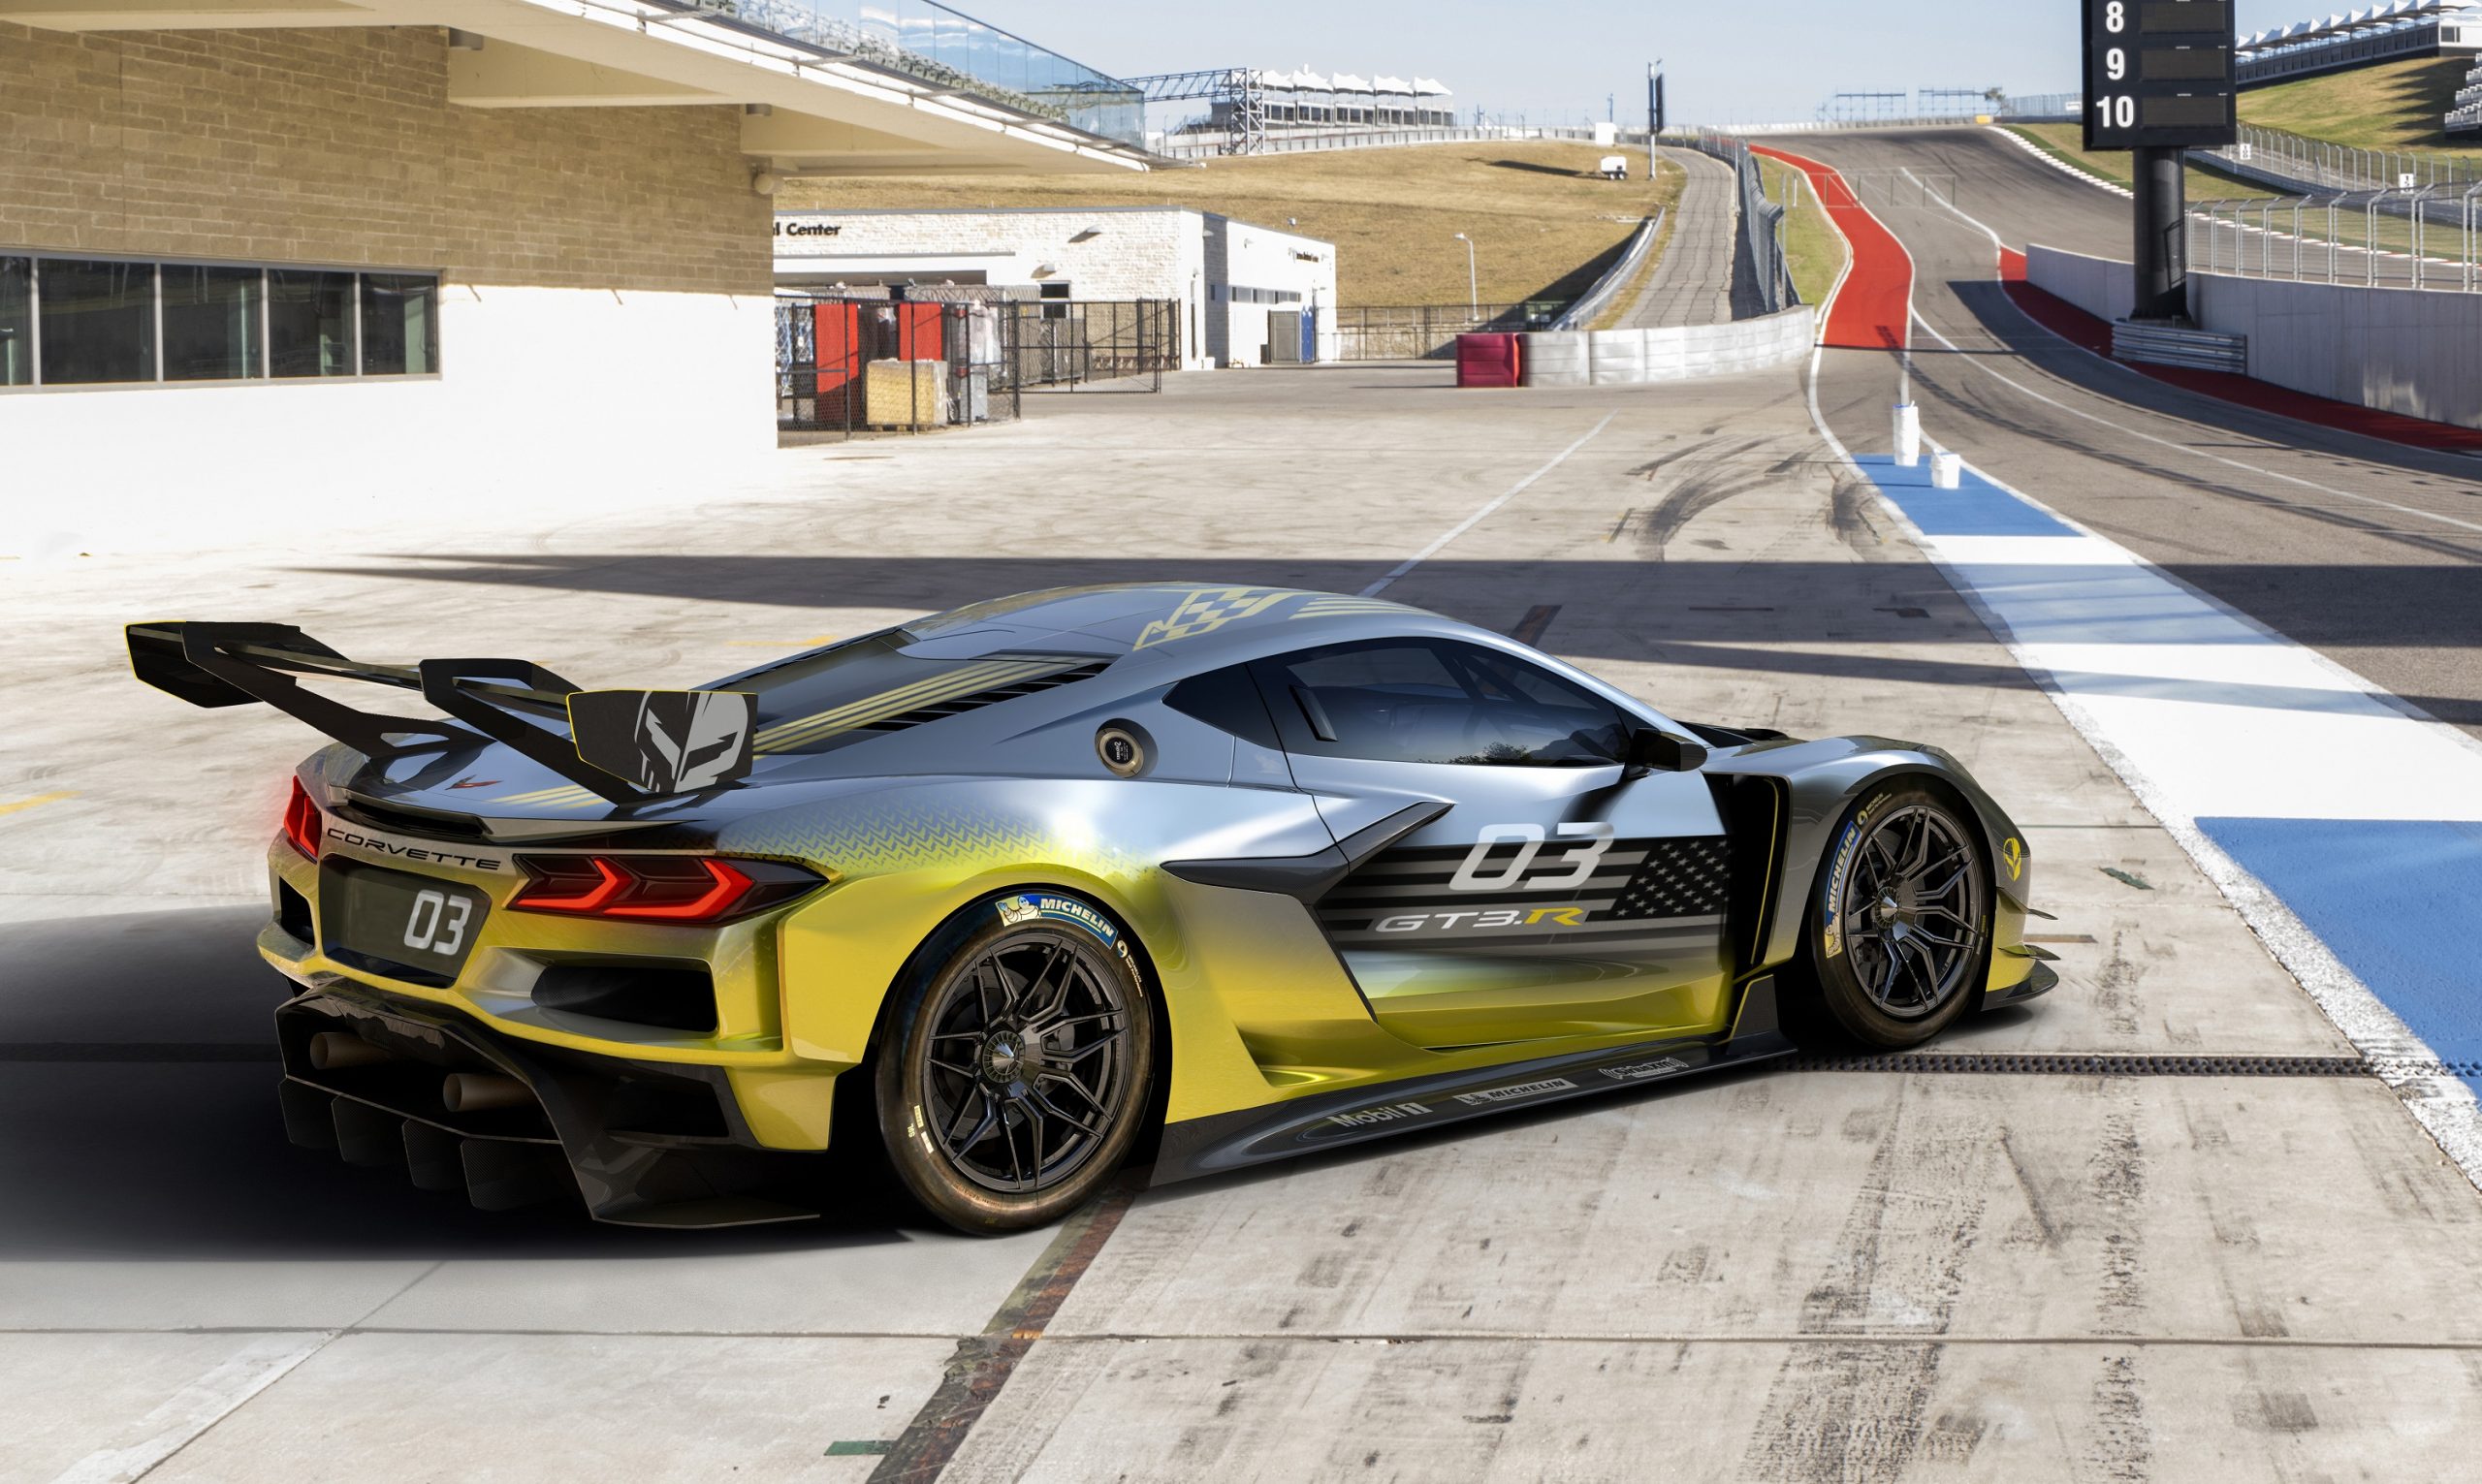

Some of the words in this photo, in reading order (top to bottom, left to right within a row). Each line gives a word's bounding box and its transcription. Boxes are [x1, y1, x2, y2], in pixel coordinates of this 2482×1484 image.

[2105, 1, 2124, 33] 8
[2106, 47, 2125, 80] 9
[2096, 95, 2135, 128] 10
[786, 222, 842, 236] Center
[327, 827, 502, 870] CORVETTE
[1448, 821, 1614, 891] 03
[1828, 826, 1857, 914] MICHELIN
[403, 889, 473, 956] 03
[1040, 898, 1115, 938] MICHELIN
[1375, 906, 1584, 932] GT3.R
[1487, 1079, 1567, 1098] MICHELIN
[1326, 1106, 1408, 1127] Mobil
